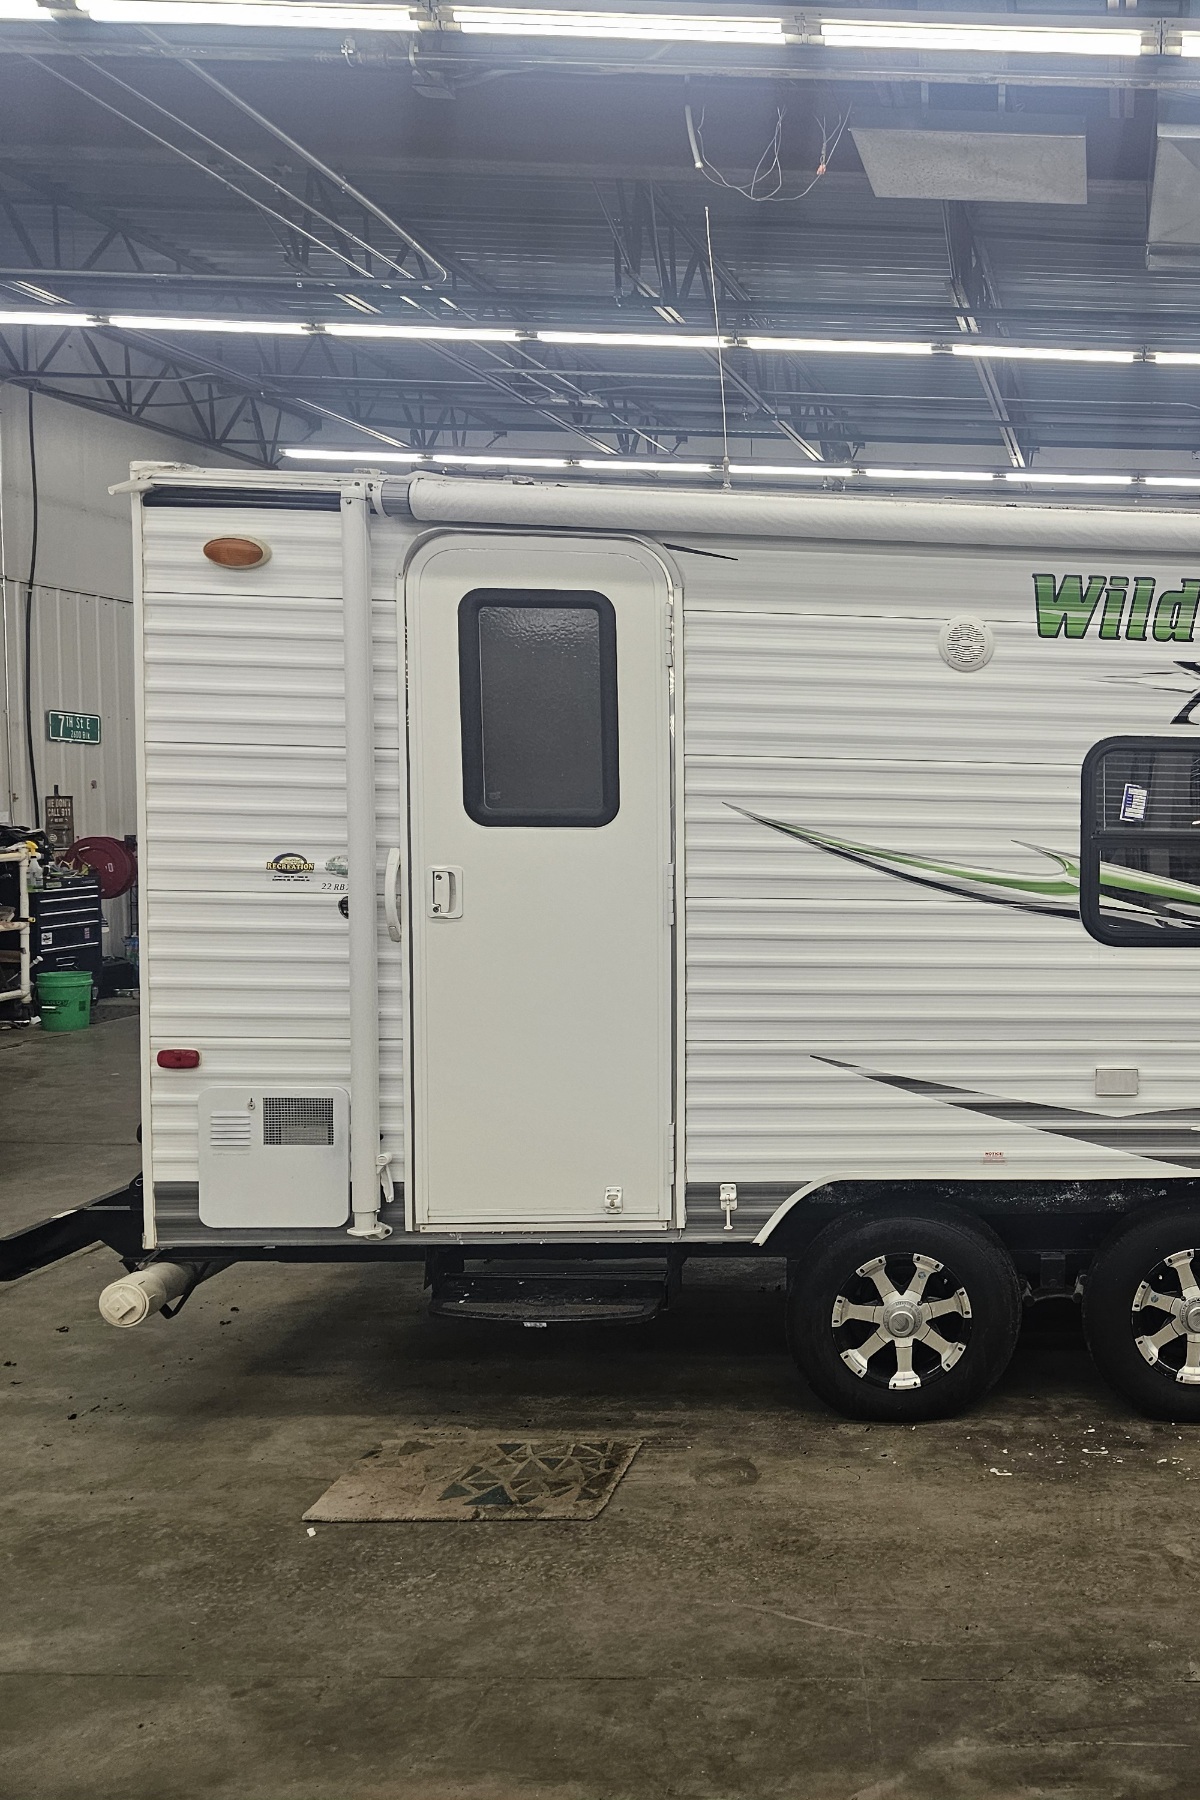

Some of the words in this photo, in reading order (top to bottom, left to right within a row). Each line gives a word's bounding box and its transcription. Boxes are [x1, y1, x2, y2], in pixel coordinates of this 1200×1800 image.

[86, 718, 91, 730] E
[48, 808, 61, 817] CALL
[61, 808, 71, 817] 911
[266, 862, 315, 871] RECREATION
[321, 882, 333, 890] 22
